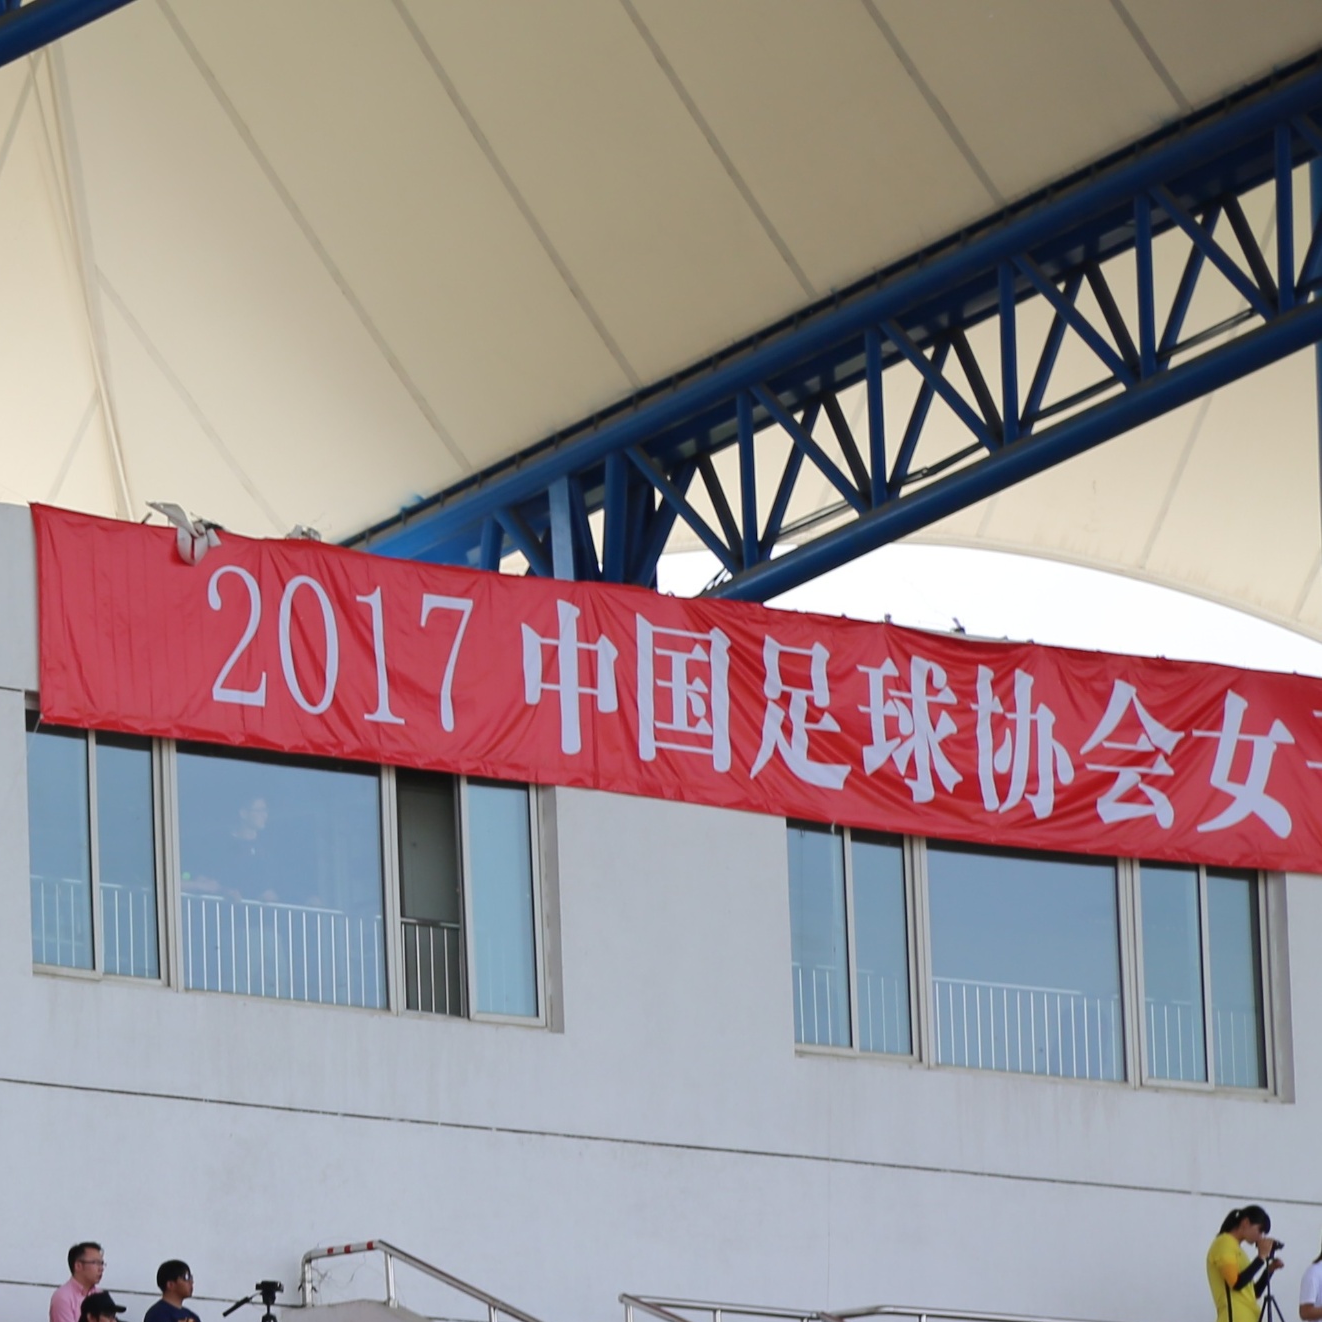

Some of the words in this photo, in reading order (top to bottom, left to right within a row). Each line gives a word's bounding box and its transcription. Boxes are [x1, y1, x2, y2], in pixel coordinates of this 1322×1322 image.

[207, 565, 473, 733] 2017
[520, 599, 1322, 839] 中国足球协会女
